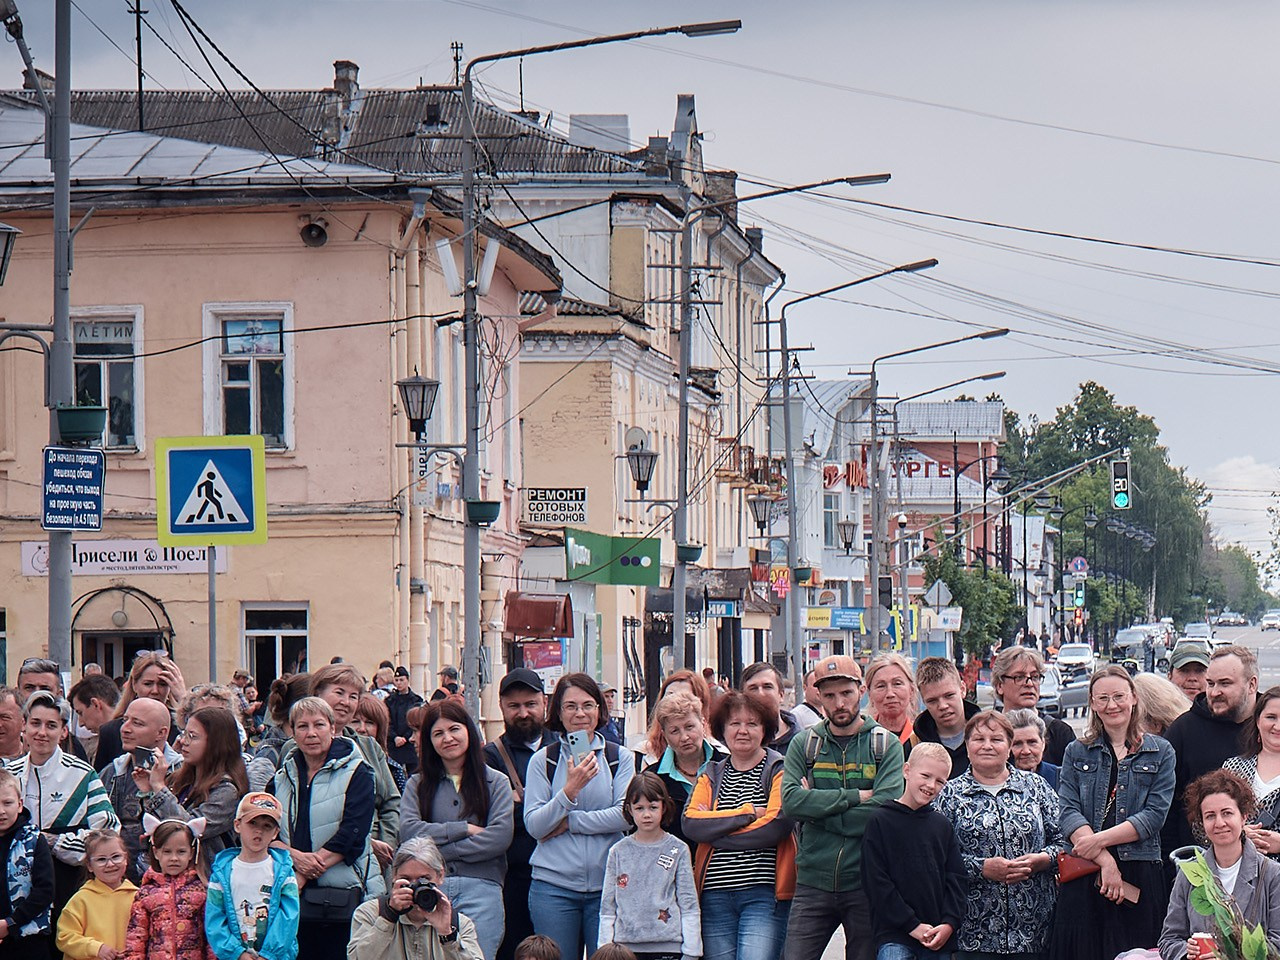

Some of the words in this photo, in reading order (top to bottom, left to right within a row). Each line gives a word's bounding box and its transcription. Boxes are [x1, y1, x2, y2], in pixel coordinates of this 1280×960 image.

[49, 450, 56, 463] До
[57, 453, 75, 463] начала
[76, 454, 98, 465] перехода
[53, 468, 76, 479] пешеход
[77, 467, 93, 479] обязан
[891, 460, 967, 478] УРГЕ
[45, 481, 74, 495] убедиться,
[75, 485, 84, 494] что
[84, 485, 100, 496] выход
[1114, 478, 1128, 492] 20
[528, 489, 585, 500] РЕМОНТ
[49, 500, 56, 508] на
[83, 501, 96, 510] часть
[528, 502, 585, 512] СОТОВЫХ
[45, 512, 73, 524] безопасен
[528, 513, 585, 522] ТЕЛЕФОНОВ
[163, 546, 215, 562] Поел
